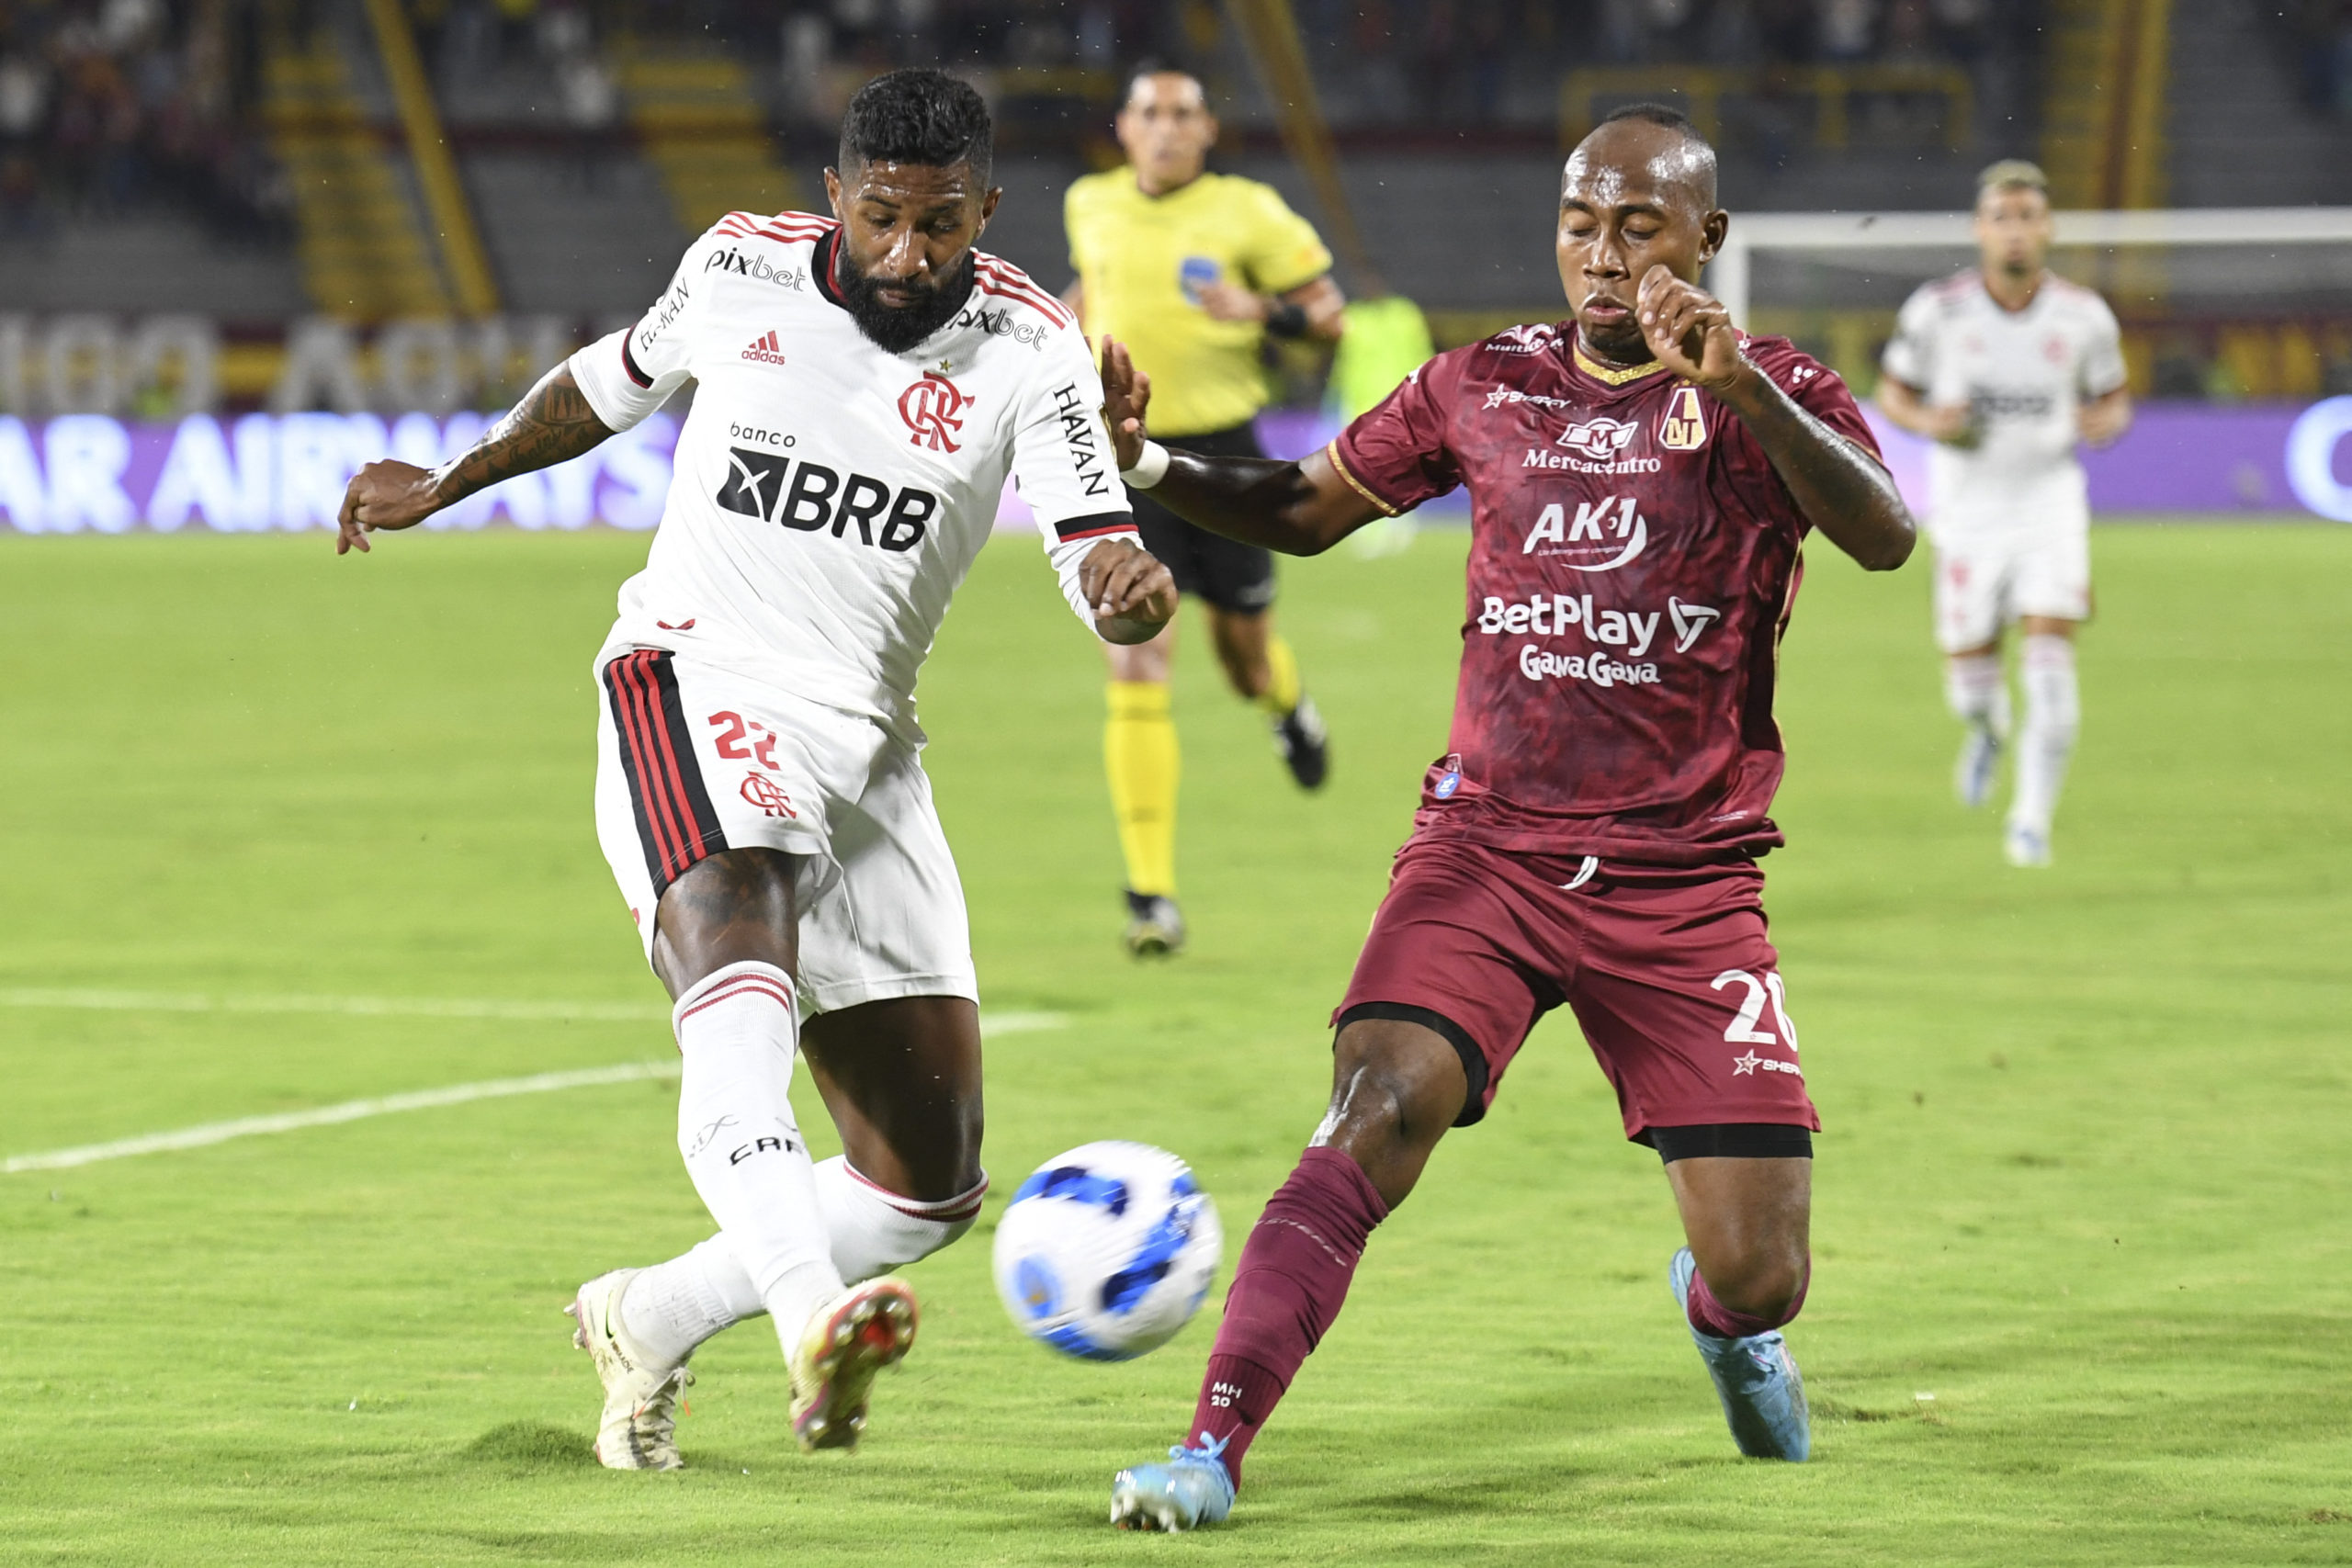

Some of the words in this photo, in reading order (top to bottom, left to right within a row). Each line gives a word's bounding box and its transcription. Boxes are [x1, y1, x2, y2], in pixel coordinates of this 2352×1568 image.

[704, 246, 807, 292] pixbet
[741, 349, 786, 366] adidas
[729, 421, 797, 448] banco
[1053, 380, 1110, 497] HAVAN
[1521, 448, 1661, 476] Mercacentro
[781, 461, 937, 552] BRB
[1477, 593, 1661, 657] BetPlay
[707, 710, 782, 772] 22
[1211, 1394, 1231, 1408] 20
[1212, 1382, 1243, 1399] MH
